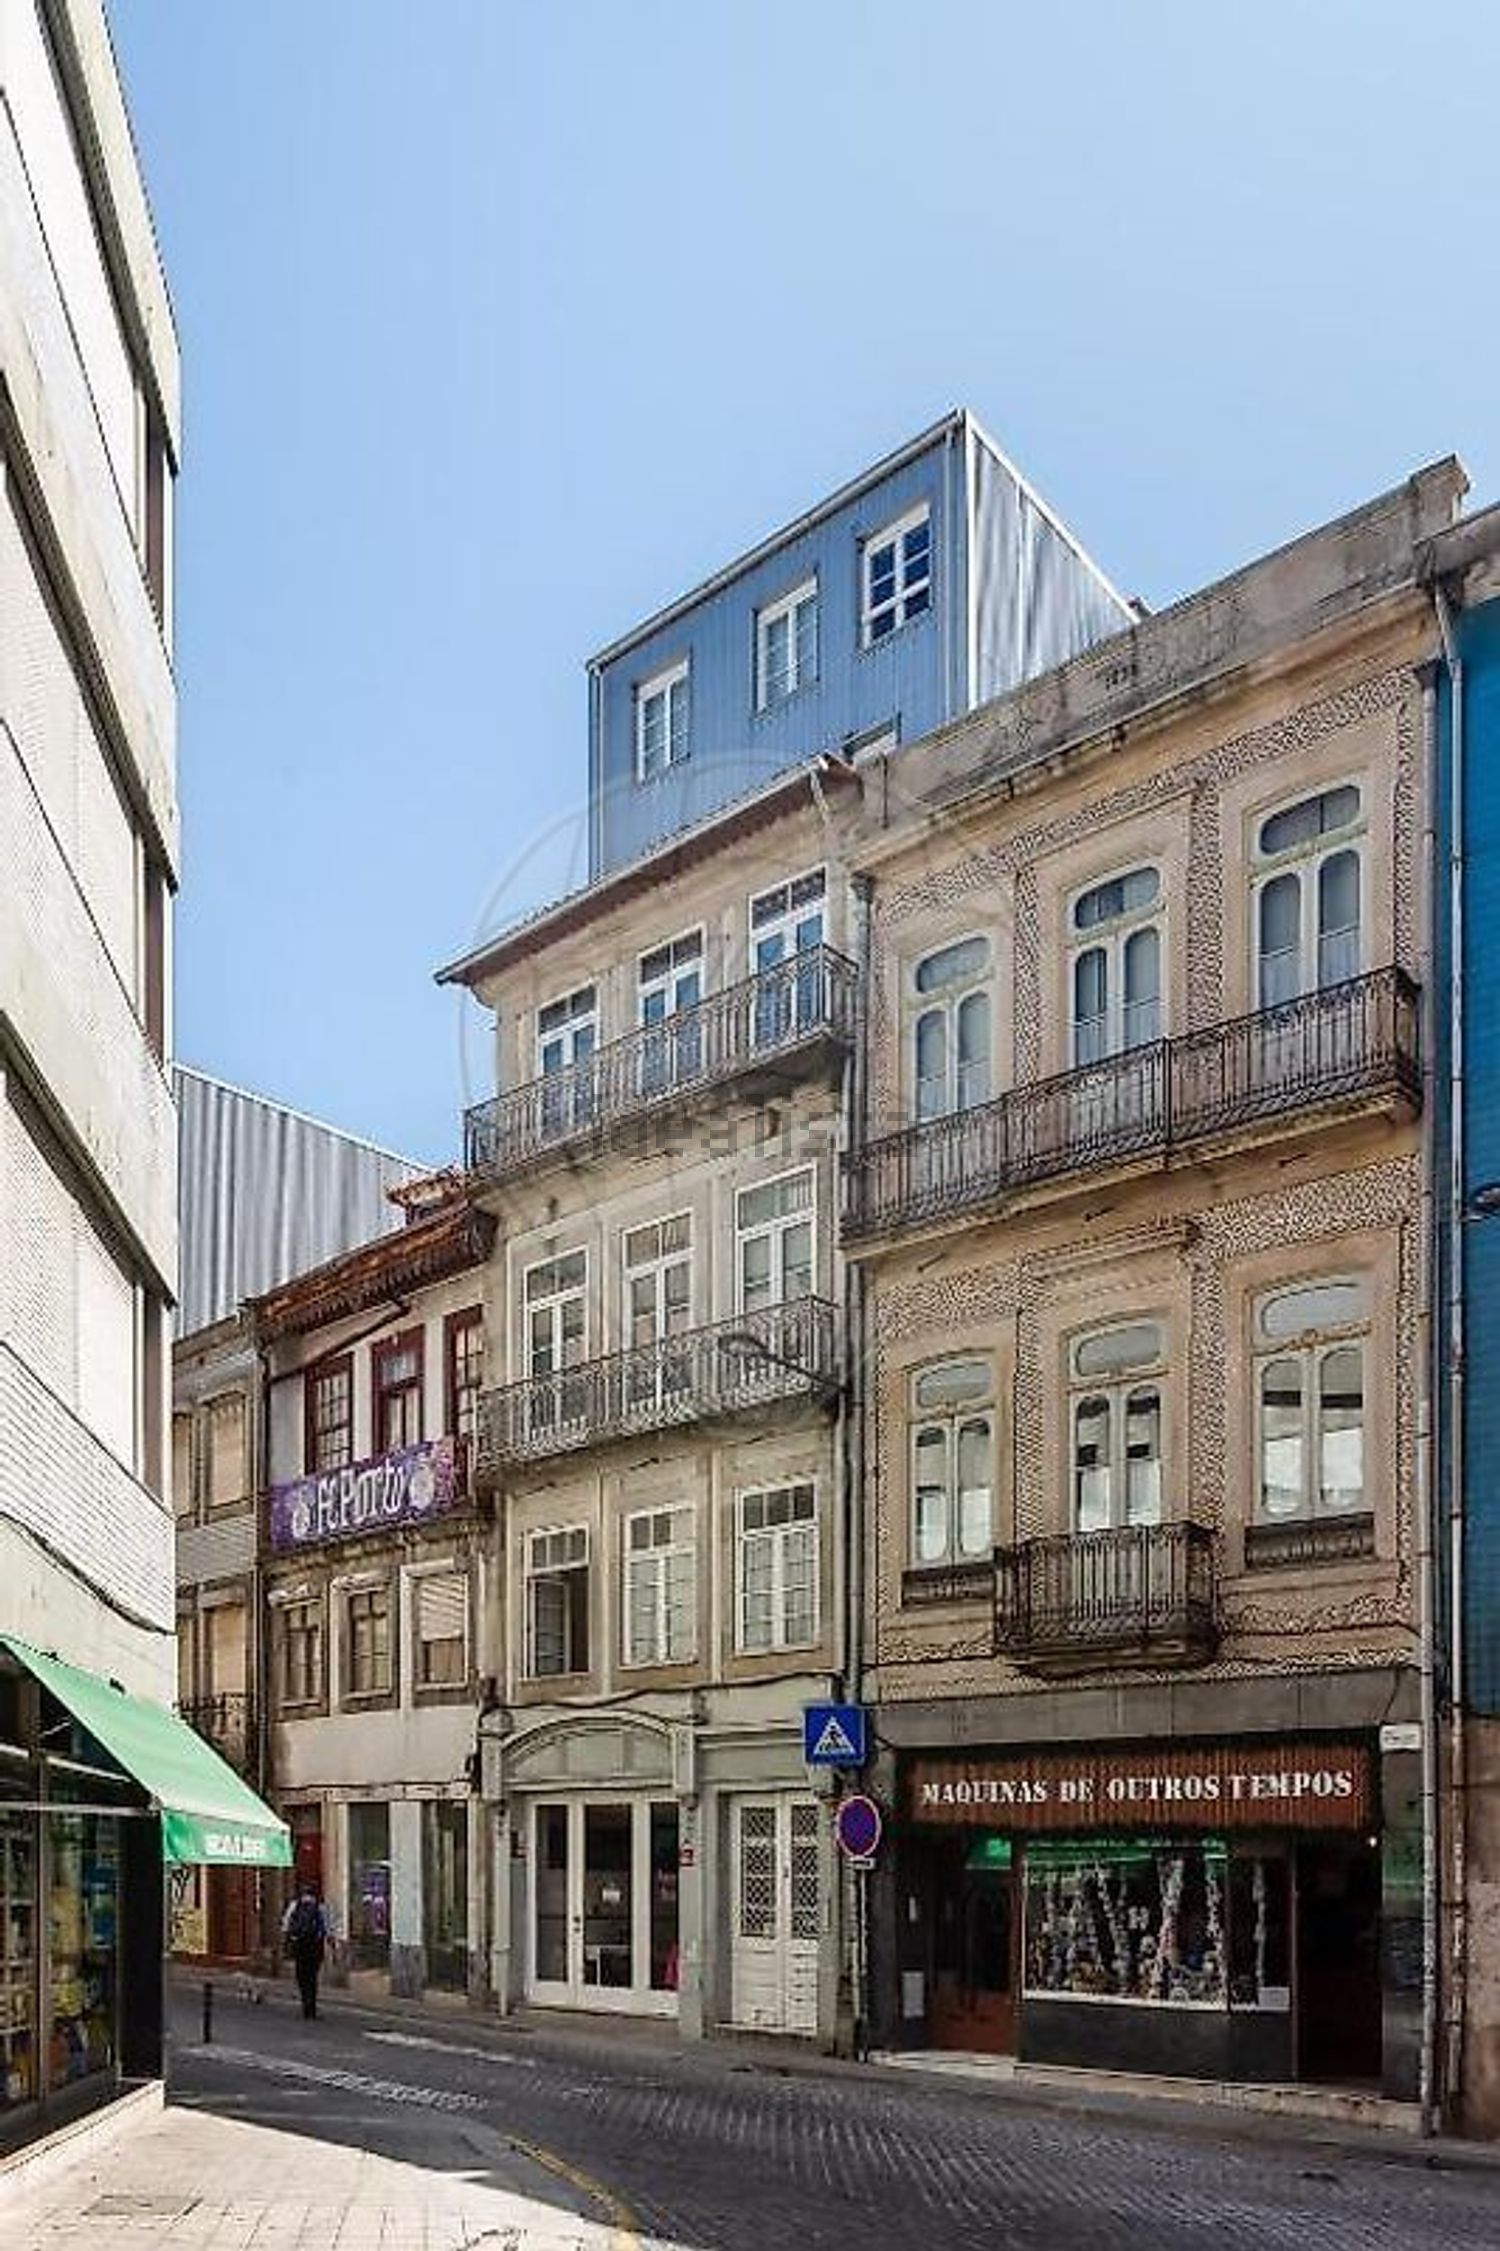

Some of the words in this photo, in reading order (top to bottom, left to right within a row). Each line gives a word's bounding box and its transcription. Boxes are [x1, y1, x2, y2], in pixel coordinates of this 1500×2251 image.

[922, 1780, 1048, 1805] MAQUINAS
[1060, 1779, 1094, 1803] DE
[1107, 1775, 1220, 1801] OUTROS
[1227, 1771, 1352, 1800] TEMPOS
